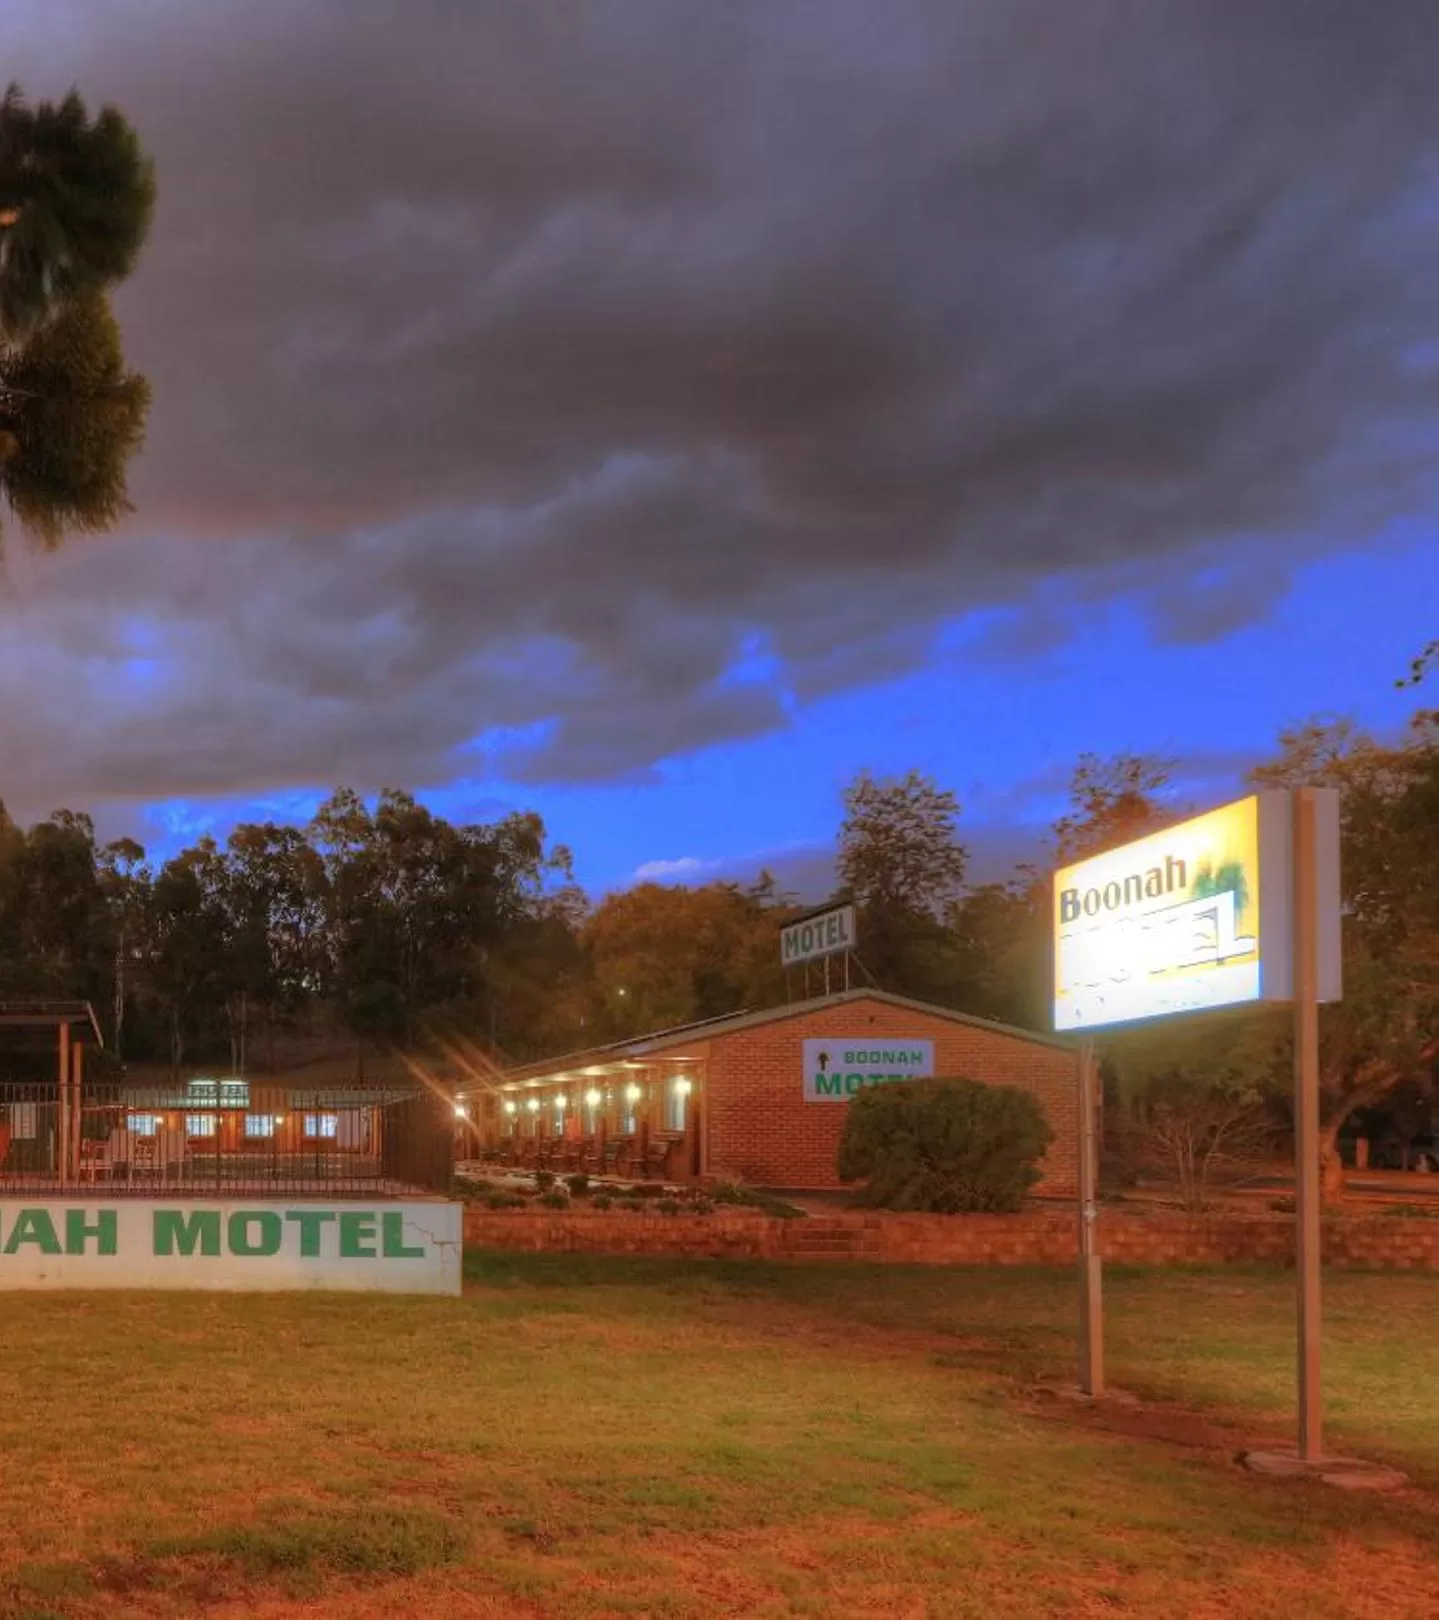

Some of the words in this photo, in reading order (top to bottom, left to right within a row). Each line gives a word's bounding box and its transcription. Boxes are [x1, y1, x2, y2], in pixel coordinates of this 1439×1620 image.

[1060, 855, 1186, 924] Boonah
[784, 911, 849, 959] MOTEL
[843, 1050, 923, 1065] BOONAH
[815, 1073, 913, 1095] MOT
[153, 1209, 426, 1258] MOTEL
